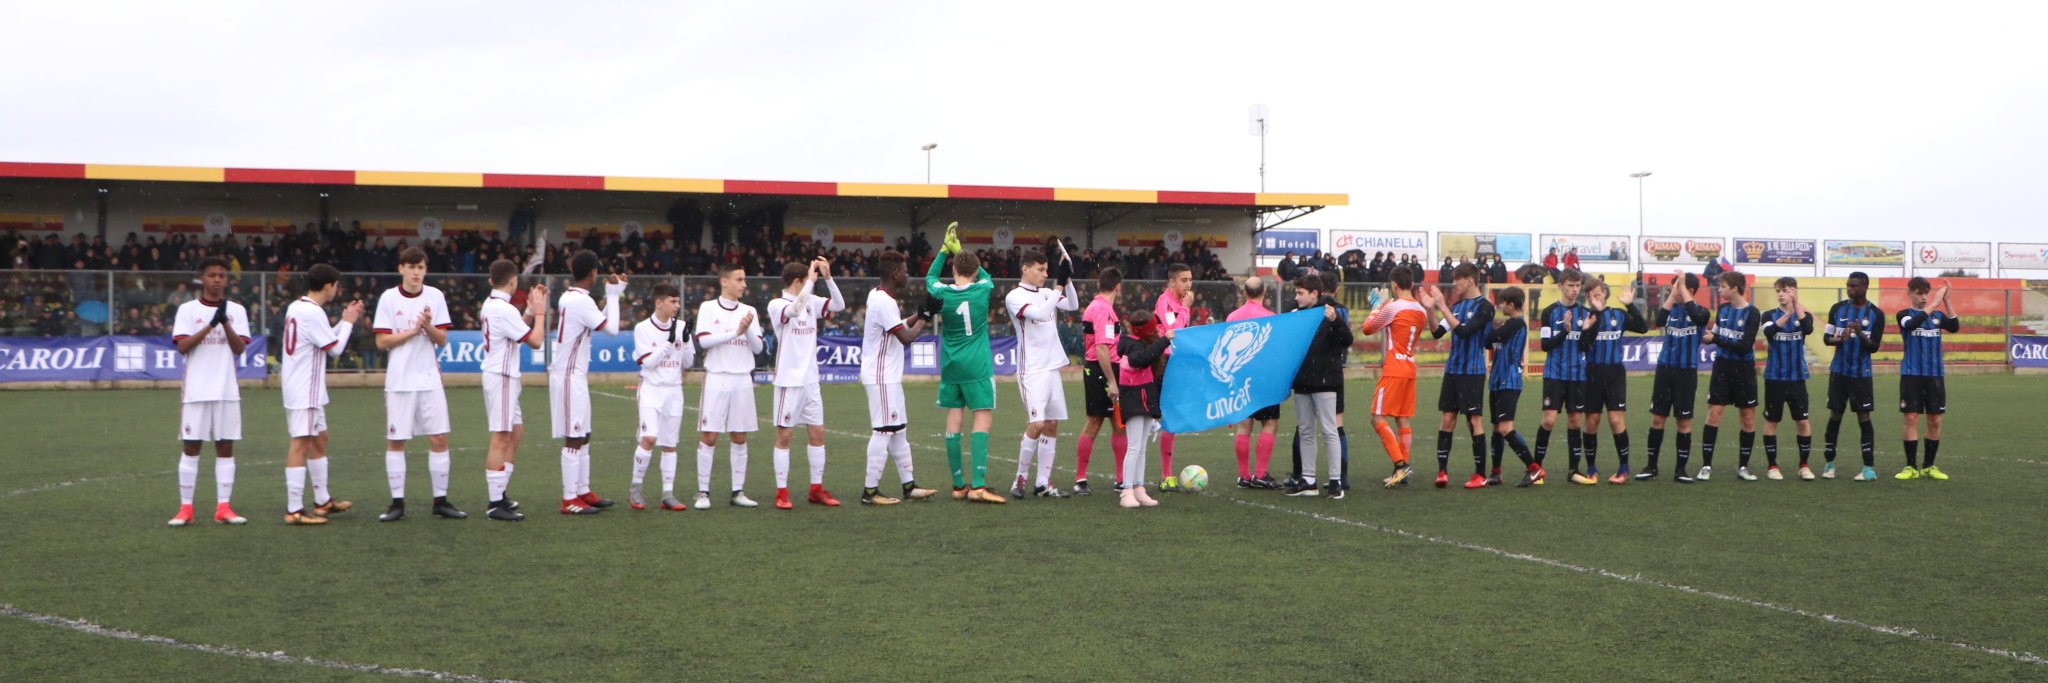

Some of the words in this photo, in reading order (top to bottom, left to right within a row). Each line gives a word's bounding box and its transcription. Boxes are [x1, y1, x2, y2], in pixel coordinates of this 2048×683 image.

[1279, 239, 1315, 249] Hotels
[1355, 236, 1424, 249] CHIANELLA
[955, 301, 972, 336] 1
[816, 345, 861, 365] CAR
[2011, 343, 2048, 359] CARO
[1206, 378, 1252, 420] unicef
